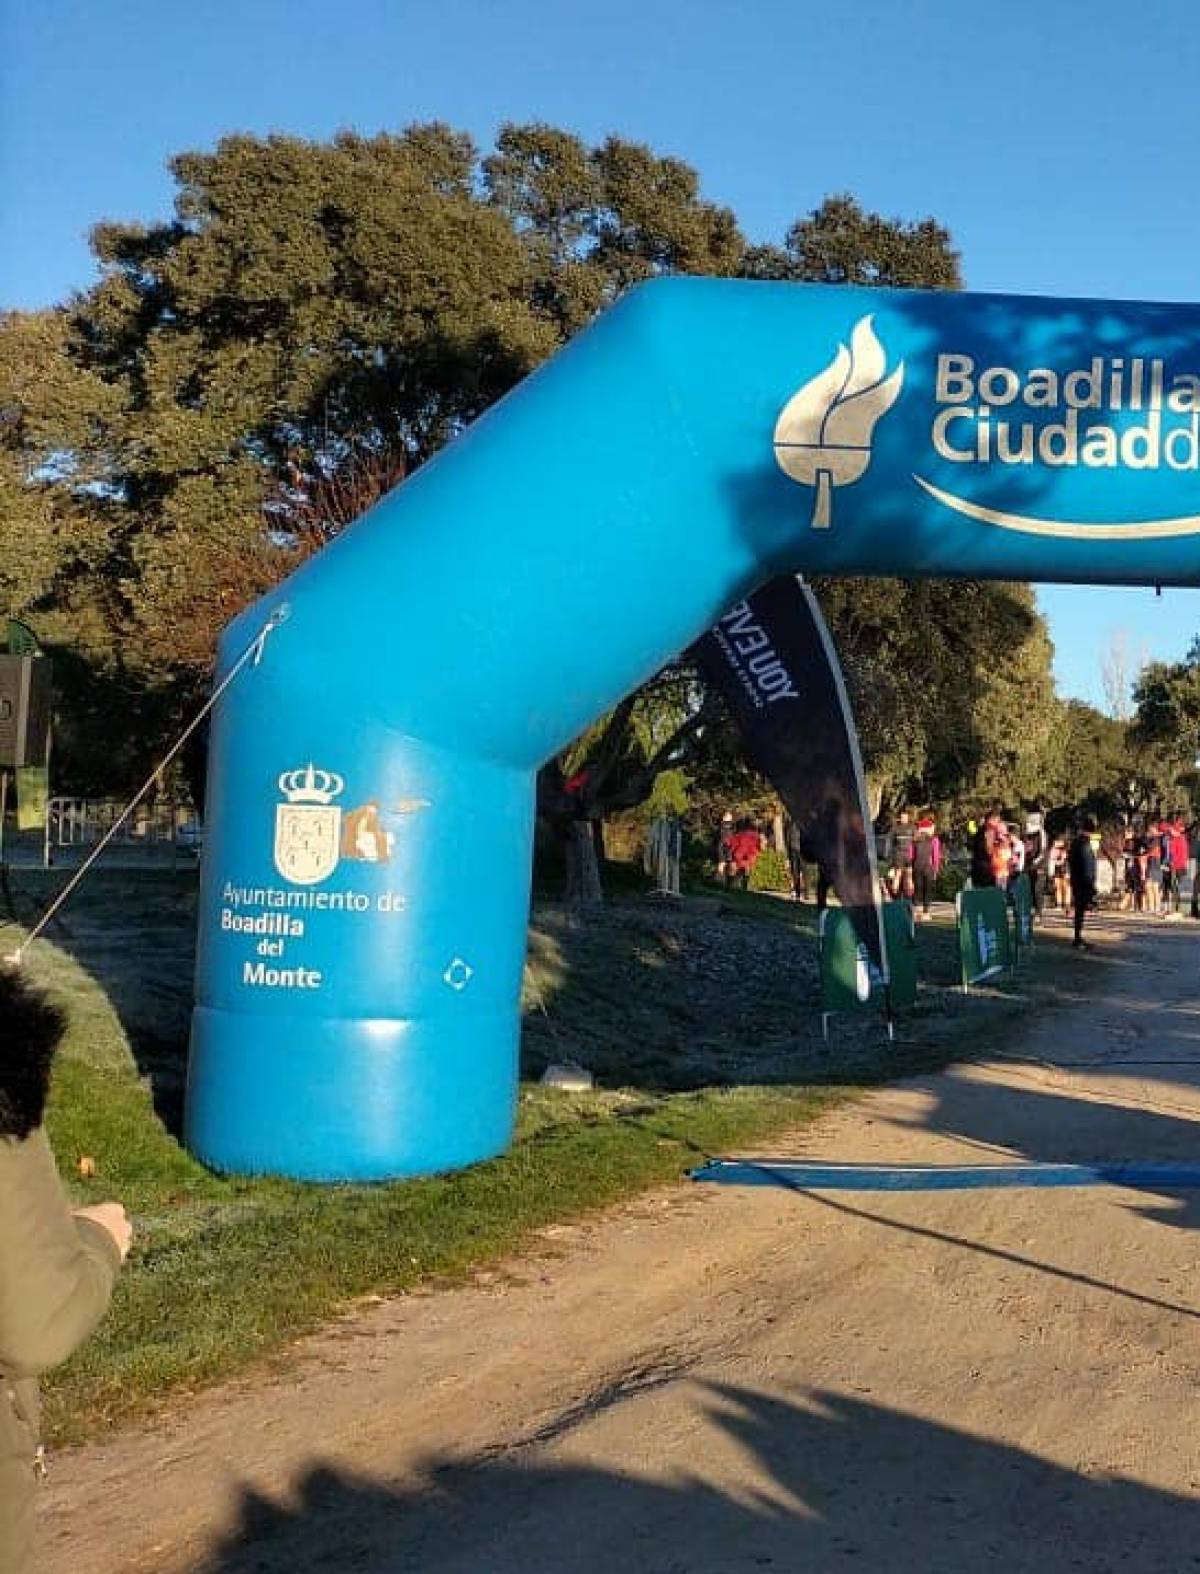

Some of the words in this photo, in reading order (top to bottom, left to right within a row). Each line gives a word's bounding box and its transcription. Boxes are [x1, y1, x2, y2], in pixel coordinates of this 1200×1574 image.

[223, 881, 370, 913] Ayuntamiento
[377, 890, 406, 912] de
[221, 908, 304, 937] Boadilla
[257, 938, 284, 957] del
[243, 961, 322, 989] Monte
